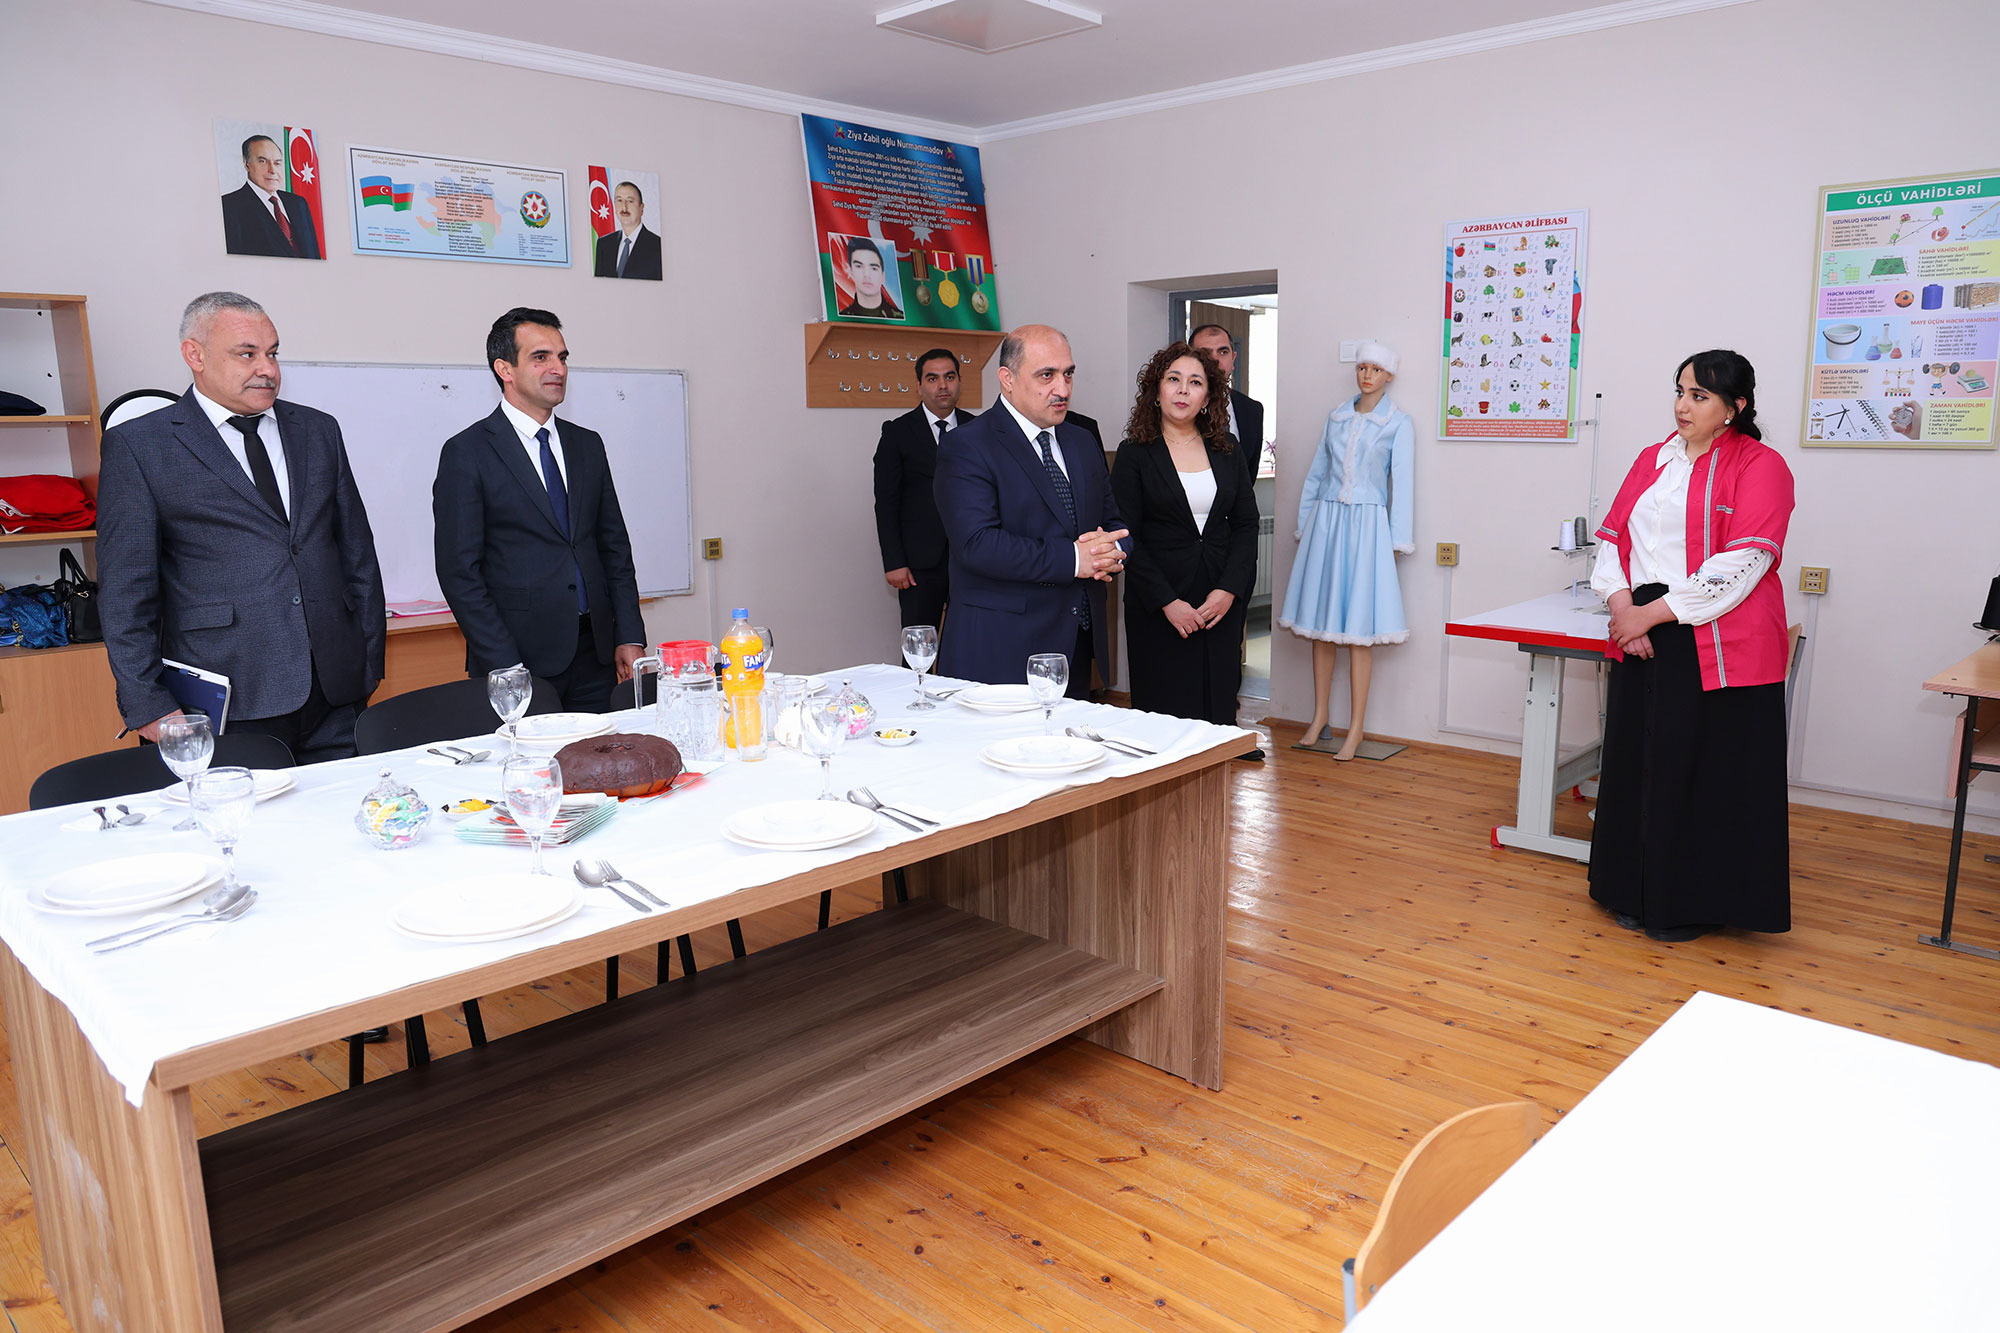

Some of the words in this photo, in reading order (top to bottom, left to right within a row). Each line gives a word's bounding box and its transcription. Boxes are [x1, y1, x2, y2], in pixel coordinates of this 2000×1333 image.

[847, 129, 862, 141] Ziya
[863, 132, 880, 143] Zabil
[881, 138, 895, 147] oğlu
[1856, 190, 1893, 206] ÖLÇÜ
[1900, 182, 1982, 201] VAHİDLƏRİ
[1462, 221, 1523, 233] AZƏRBAYCAN
[1525, 217, 1568, 228] ƏLİFBASI
[1860, 214, 1891, 222] VAHİDLƏRİ
